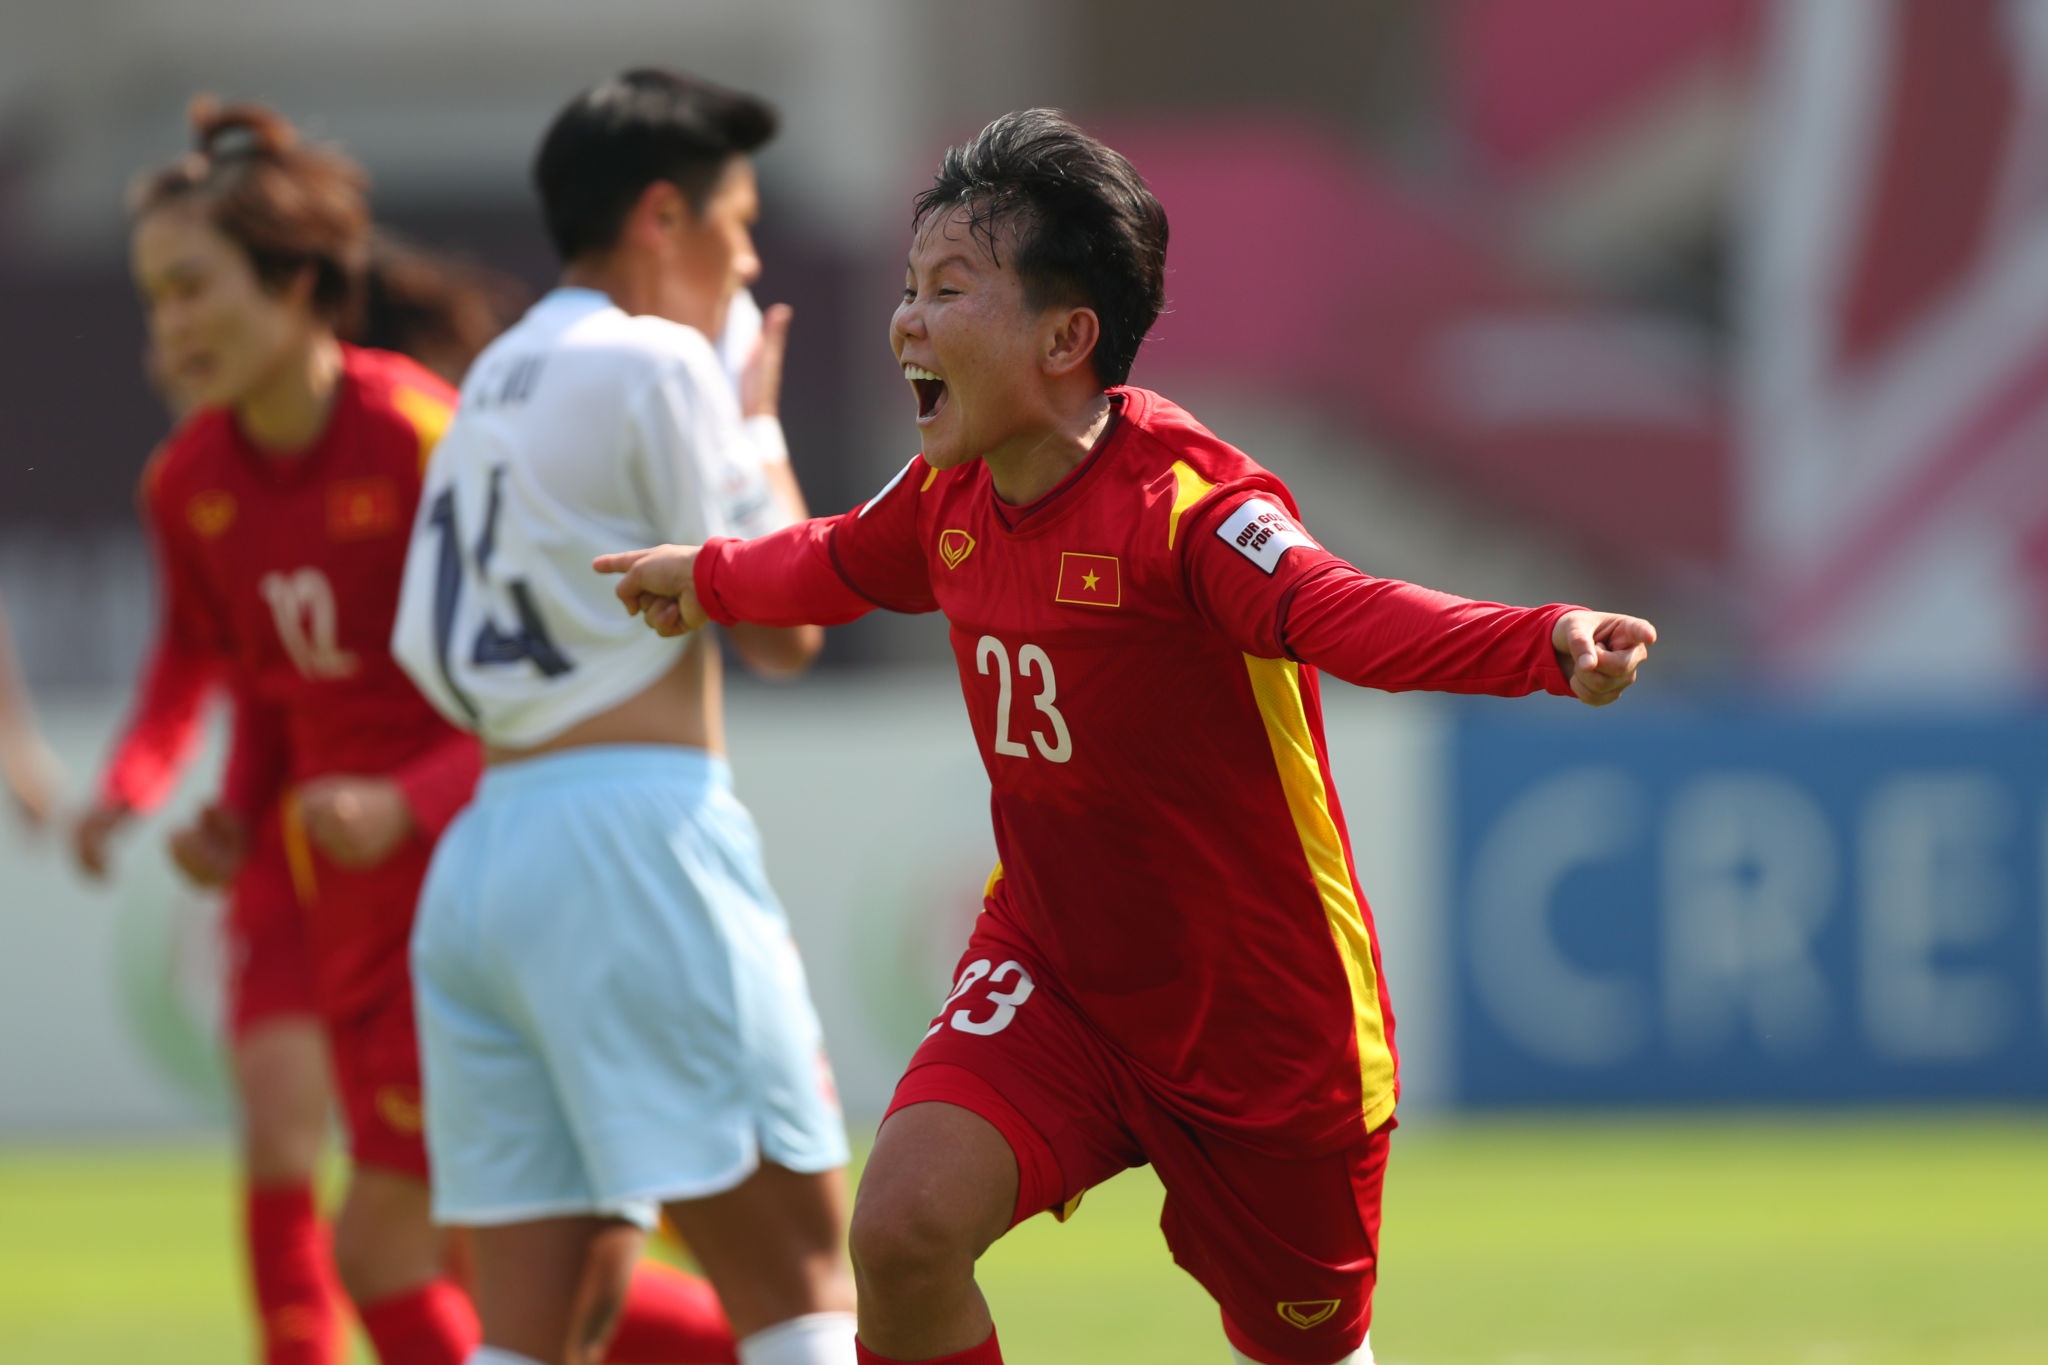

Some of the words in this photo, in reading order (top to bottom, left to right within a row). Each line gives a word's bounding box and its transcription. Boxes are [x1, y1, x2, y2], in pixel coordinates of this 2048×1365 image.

[1235, 521, 1260, 547] OUR
[1257, 512, 1287, 525] GO
[1250, 527, 1275, 551] FOR
[257, 565, 361, 682] 12
[976, 635, 1073, 763] 23
[1467, 766, 2048, 1068] CRE
